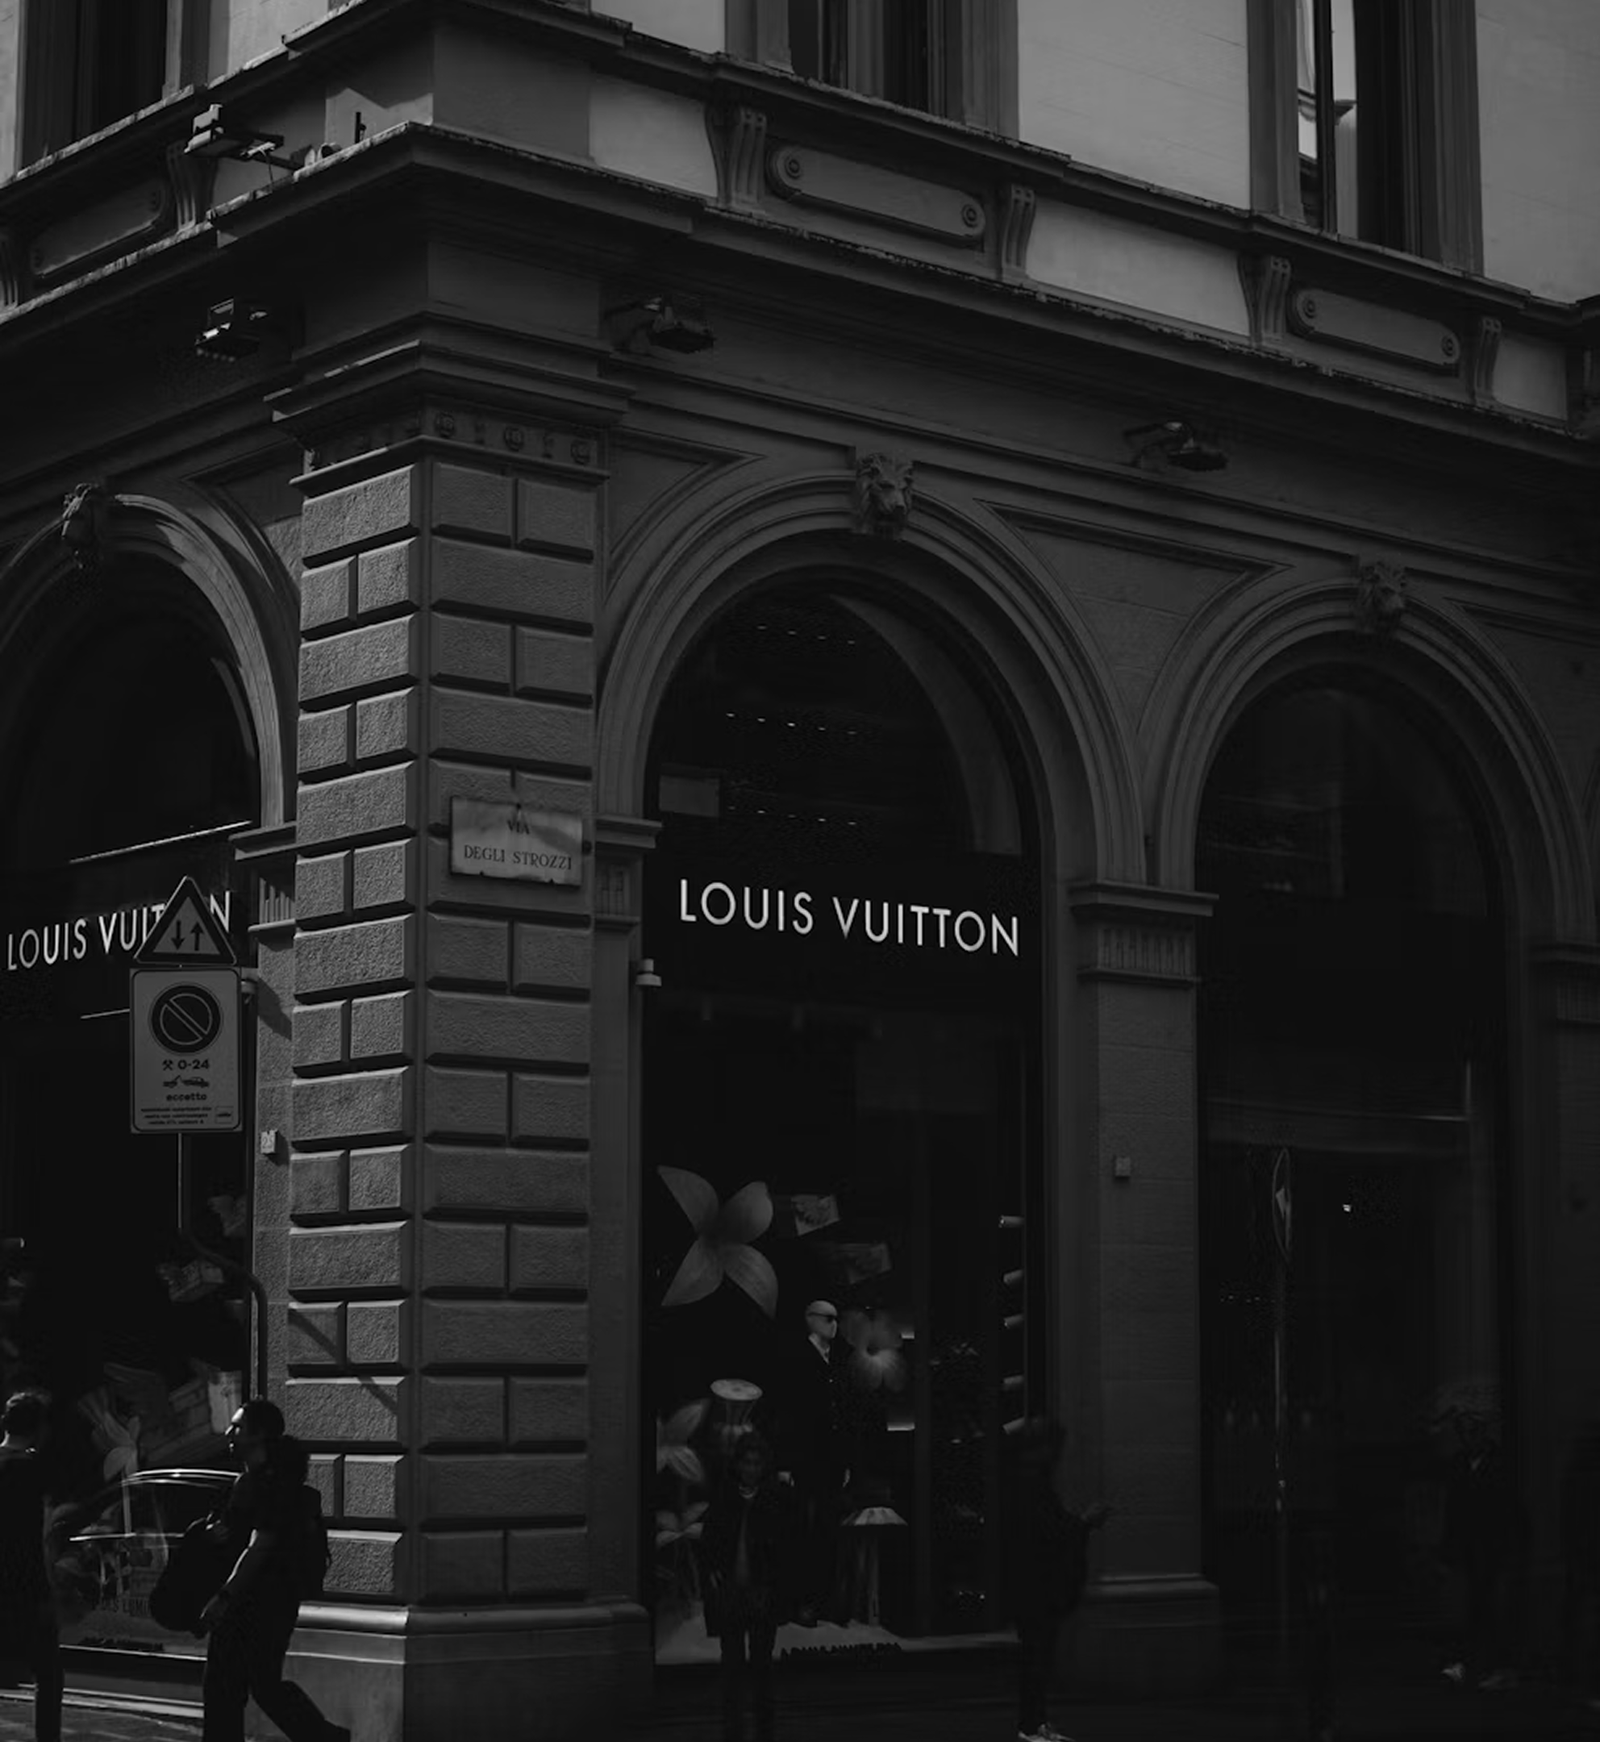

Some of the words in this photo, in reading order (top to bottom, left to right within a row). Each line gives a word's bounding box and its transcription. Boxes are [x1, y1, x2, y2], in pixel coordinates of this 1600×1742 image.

[506, 819, 531, 835] VIA
[463, 844, 506, 863] DEGLI
[512, 850, 573, 871] STROZZI
[679, 877, 815, 936] LOUIS
[831, 895, 1020, 958] VUITTON
[7, 917, 88, 972] LOUIS
[98, 889, 232, 955] VUITN
[177, 1059, 210, 1071] 0-24
[166, 1092, 207, 1102] eccetto
